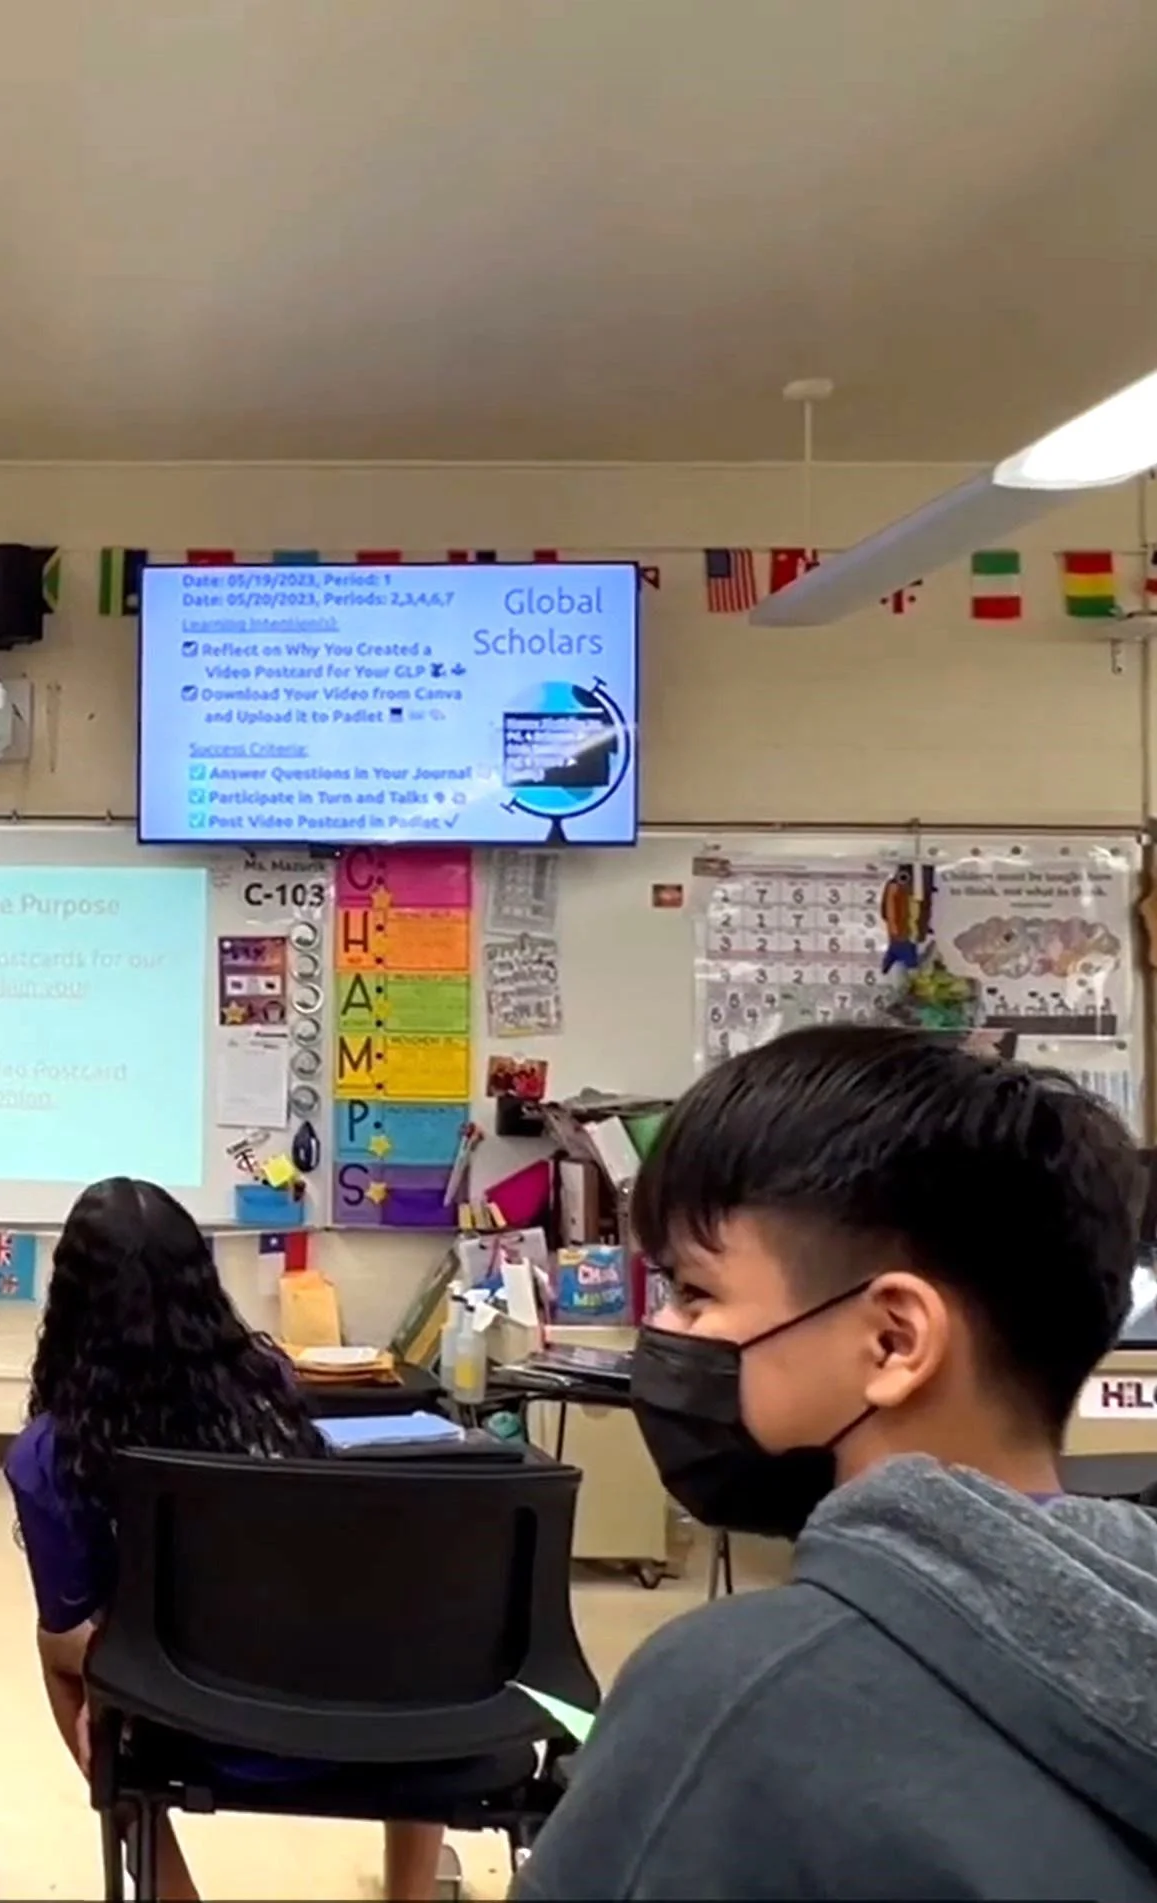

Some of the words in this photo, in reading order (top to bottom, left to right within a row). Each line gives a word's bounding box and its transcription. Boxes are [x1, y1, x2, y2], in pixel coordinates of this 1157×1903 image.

[182, 574, 224, 588] Date:
[227, 573, 320, 589] 05/19/2023,
[324, 574, 381, 588] Period:
[384, 574, 392, 586] 1
[182, 592, 224, 606] Date:
[227, 592, 320, 607] 05/20/2023,
[324, 592, 387, 606] Periods:
[504, 588, 602, 616] Global
[473, 628, 603, 656] Scholars
[202, 643, 258, 656] Reflect
[262, 645, 282, 656] on
[284, 643, 320, 659] Why
[324, 643, 352, 656] You
[356, 643, 419, 656] Created
[423, 646, 432, 656] a
[205, 665, 251, 679] Video
[254, 664, 322, 679] Postcard
[326, 664, 351, 678] for
[354, 665, 389, 678] Your
[394, 665, 425, 679] GLP
[201, 687, 279, 701] Download
[283, 688, 319, 701] Your
[323, 688, 368, 701] Video
[372, 687, 411, 701] from
[414, 688, 463, 701] Canva
[204, 709, 233, 723] and
[236, 709, 292, 725] Upload
[295, 710, 309, 723] it
[312, 711, 329, 723] to
[333, 709, 385, 723] Padlet
[209, 767, 267, 780] Answer
[271, 767, 350, 783] Questions
[354, 767, 368, 780] in
[374, 767, 409, 780] Your
[411, 766, 472, 780] Journal
[208, 791, 294, 807] Participate
[298, 791, 313, 804] in
[317, 791, 351, 804] Turn
[356, 791, 385, 804] and
[388, 791, 428, 804] Talks
[208, 814, 243, 828] Post
[247, 814, 293, 828] Video
[297, 813, 366, 828] Postcard
[369, 814, 385, 827] in
[244, 882, 325, 908] C-103
[755, 888, 768, 904] 7
[793, 888, 805, 904] 6
[828, 888, 841, 904] 3
[865, 889, 877, 904] 2
[20, 893, 120, 920] Purpose
[721, 913, 732, 927] 2
[756, 913, 766, 928] 1
[792, 914, 804, 928] 7
[864, 913, 876, 928] 3
[720, 936, 732, 952] 3
[756, 937, 768, 952] 2
[755, 967, 768, 984] 3
[792, 968, 804, 985] 2
[828, 968, 841, 985] 6
[341, 973, 374, 1016] A
[338, 1036, 373, 1079] M
[347, 1099, 371, 1142] P
[338, 1163, 369, 1207] S
